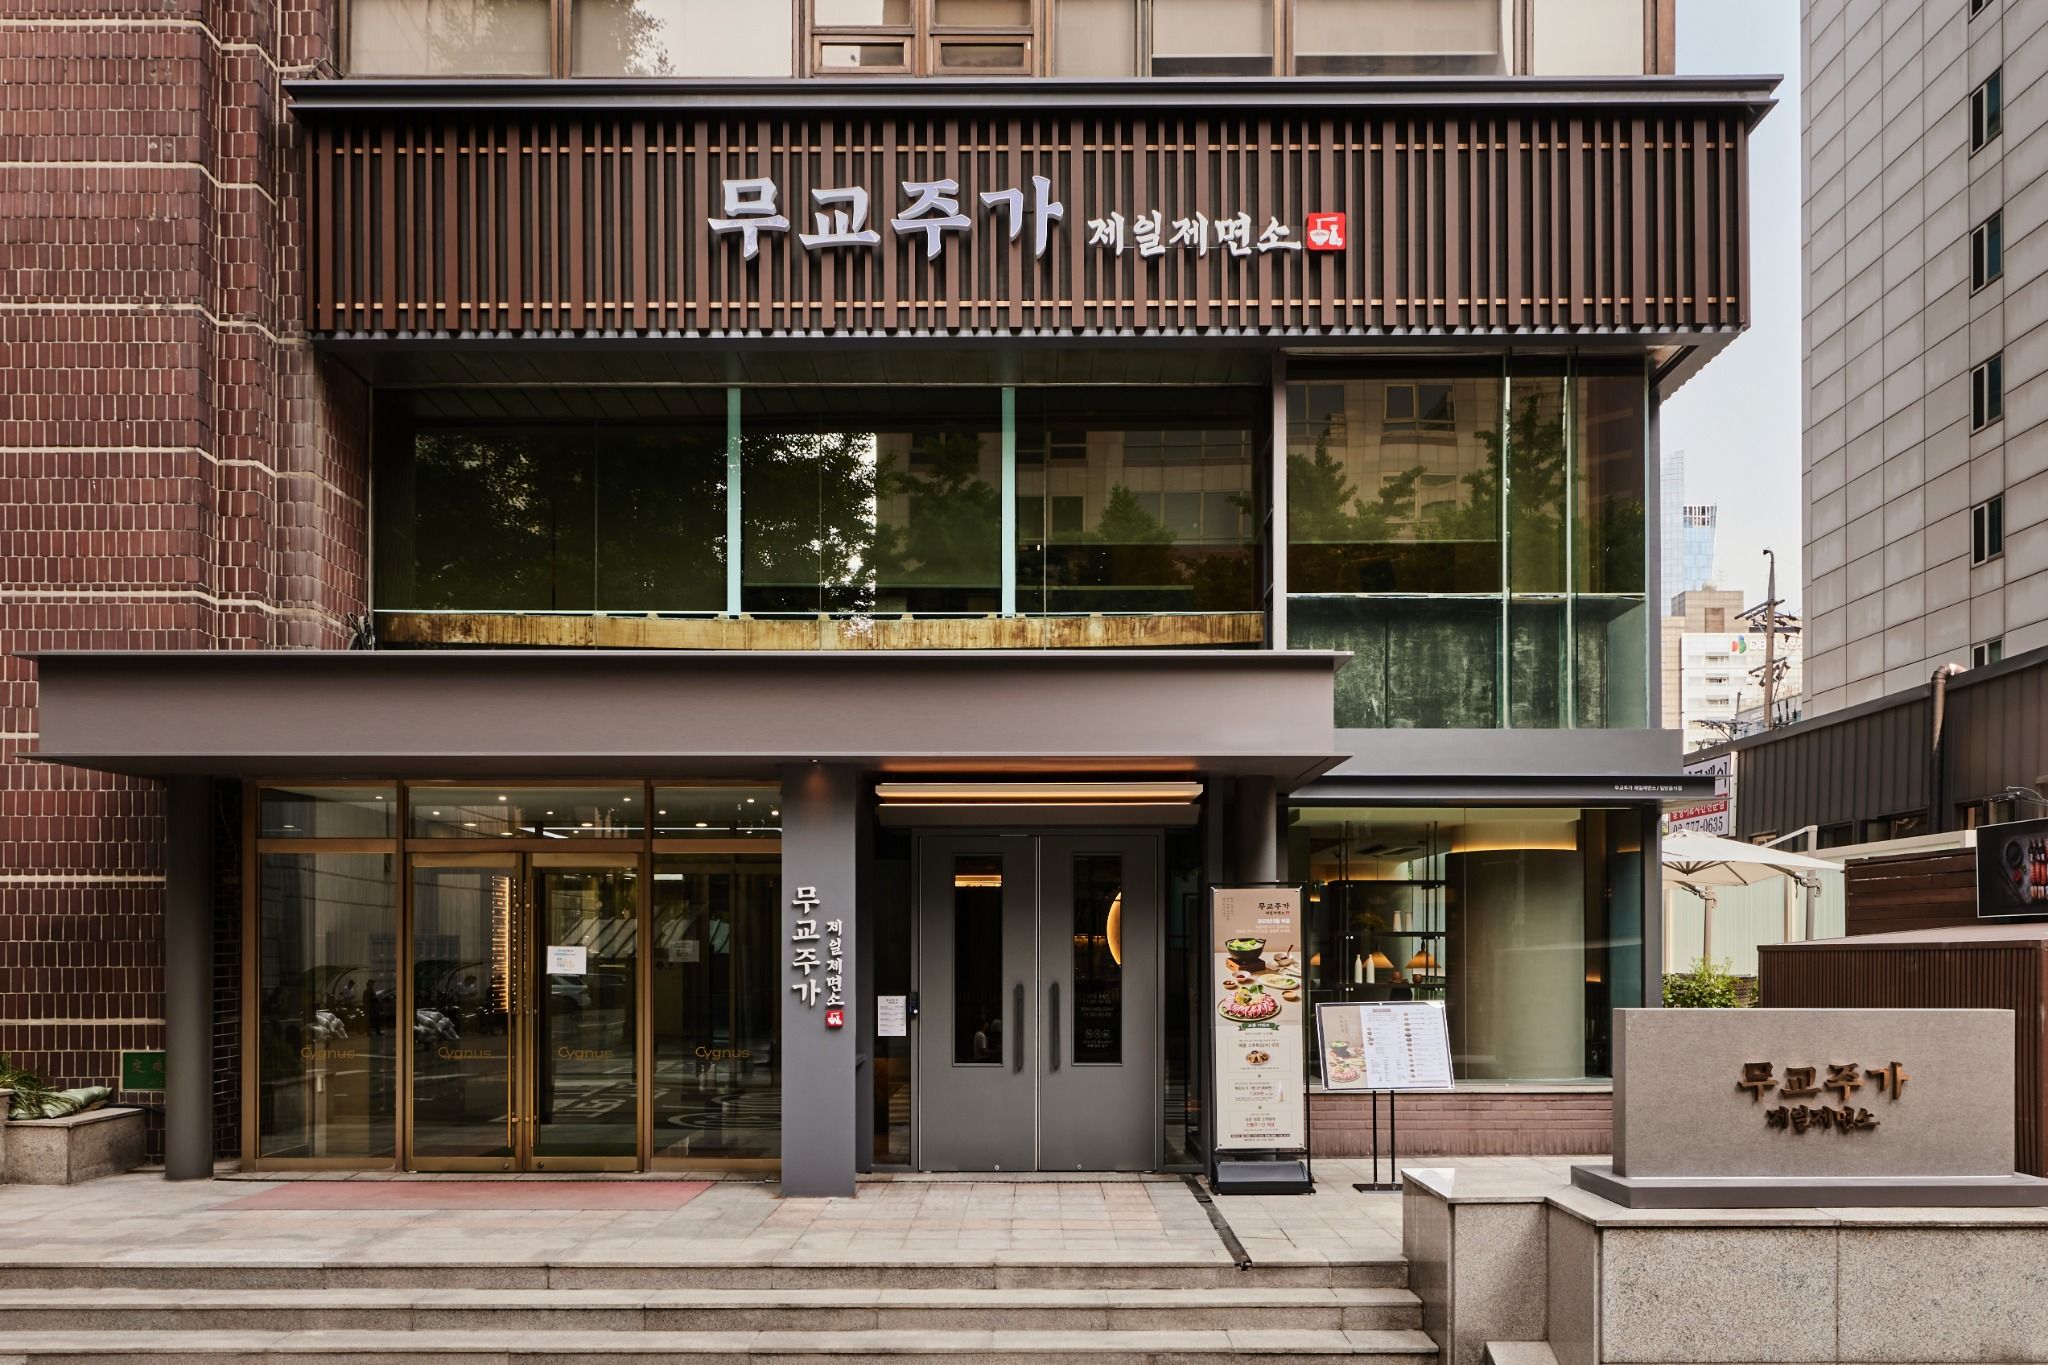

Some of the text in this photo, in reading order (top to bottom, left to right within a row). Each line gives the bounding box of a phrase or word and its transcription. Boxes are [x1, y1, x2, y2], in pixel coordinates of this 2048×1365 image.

[707, 174, 1303, 262] 무교주가 제일제면소
[791, 886, 821, 1007] 무교주가
[826, 918, 845, 1006] 제일제면소
[300, 1046, 356, 1060] Cygnus
[437, 1046, 492, 1060] Cygnus
[558, 1046, 613, 1060] Cygnus
[695, 1046, 750, 1060] Cygnus
[1736, 1061, 1911, 1102] 무교주가
